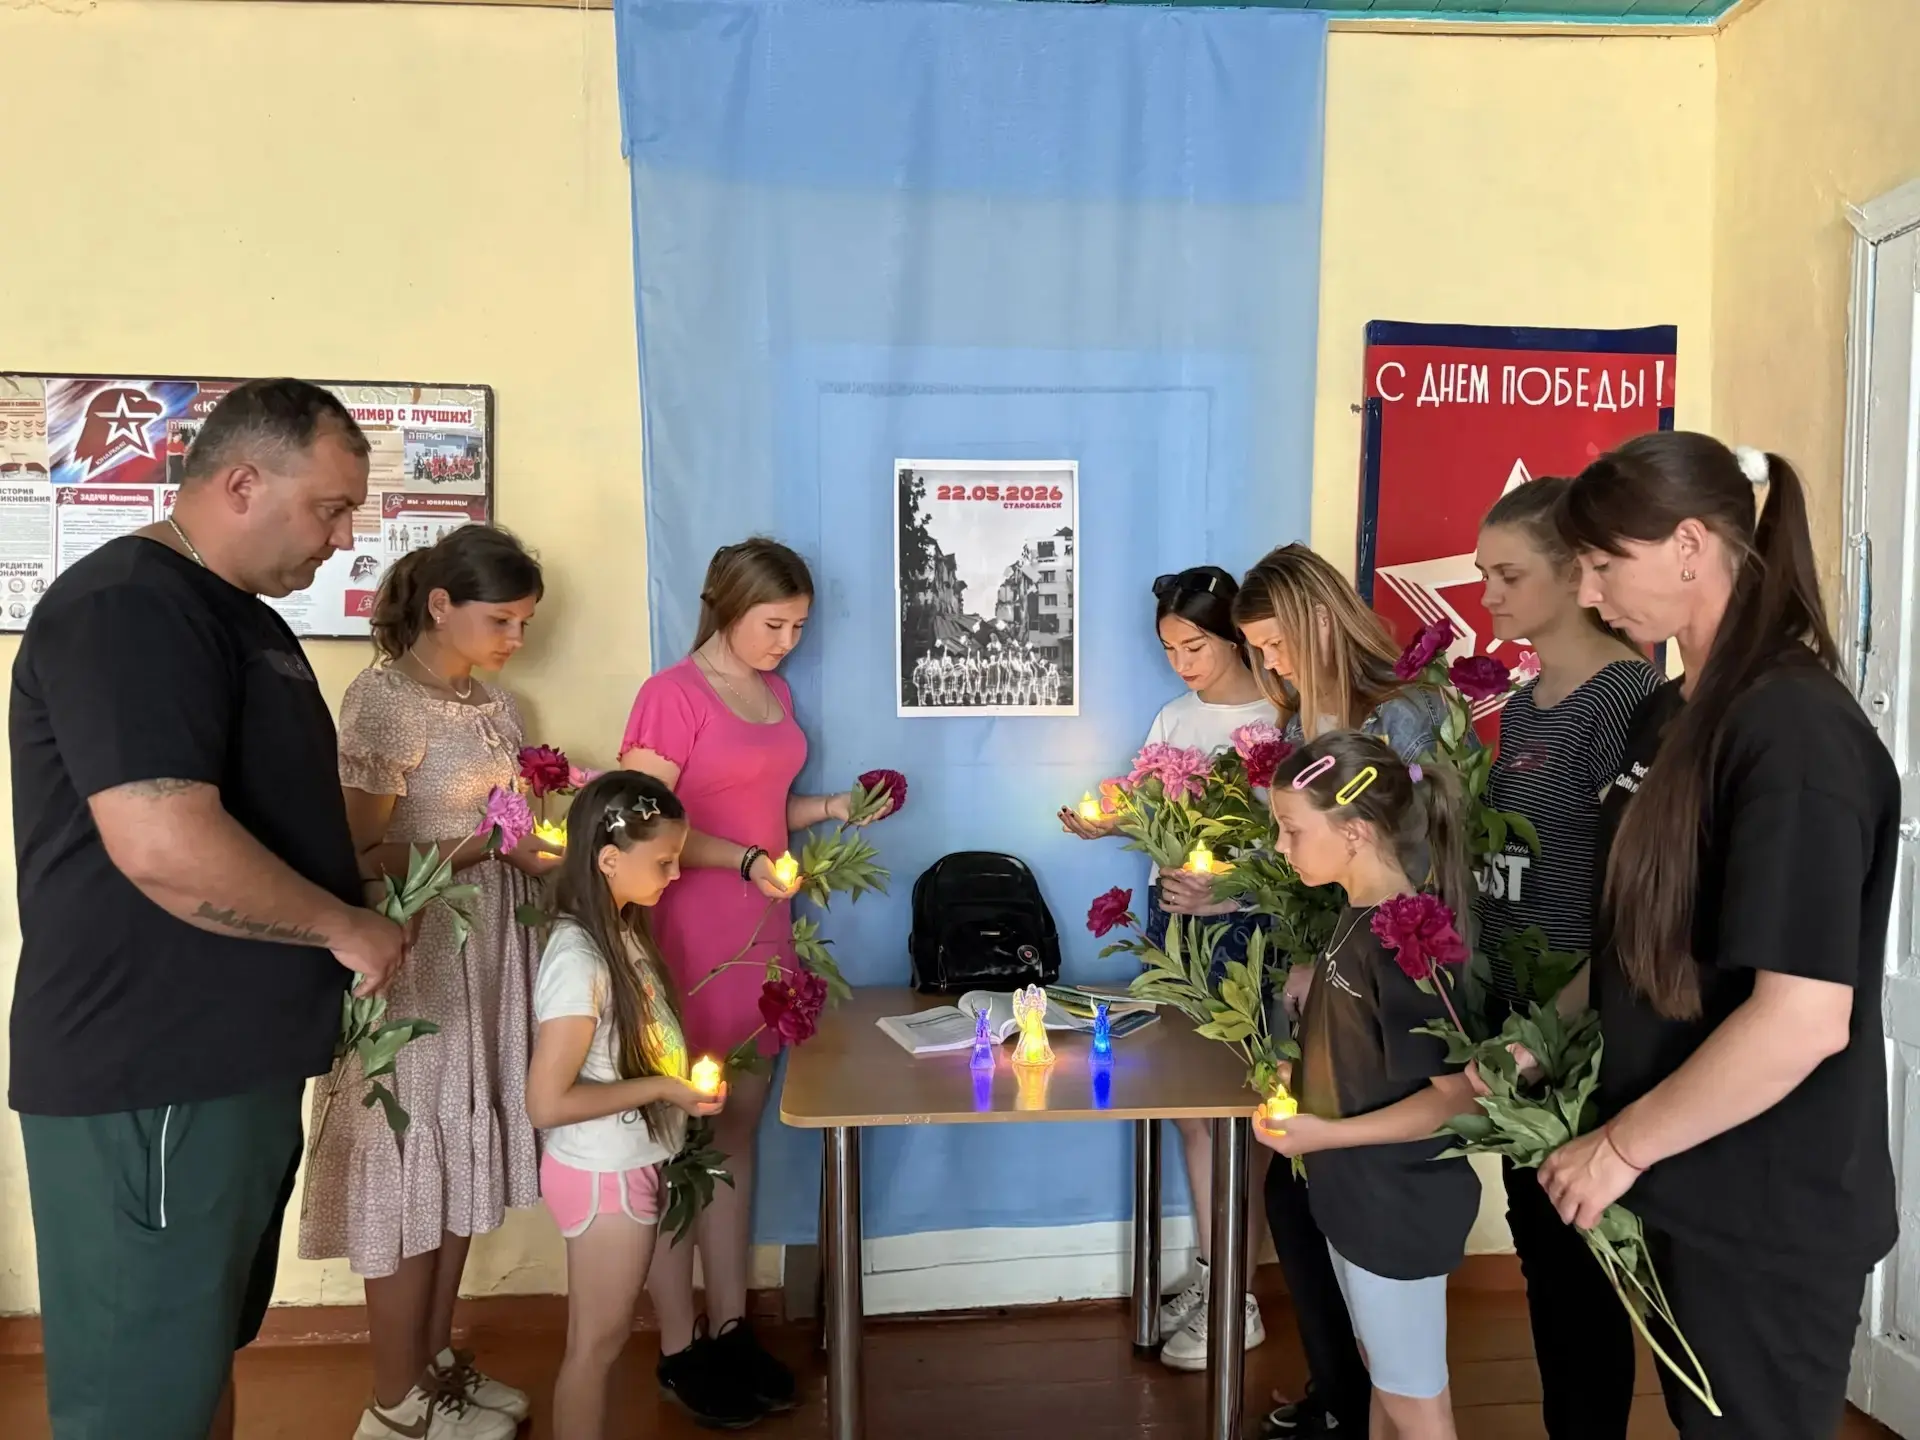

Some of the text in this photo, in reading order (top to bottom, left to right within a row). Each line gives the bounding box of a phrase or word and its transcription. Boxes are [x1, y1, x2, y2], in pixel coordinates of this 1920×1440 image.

[1375, 361, 1406, 402] С
[1416, 362, 1490, 408] ДНЕМ
[411, 409, 472, 425] лучших!
[937, 485, 1063, 501] 22.05.2026
